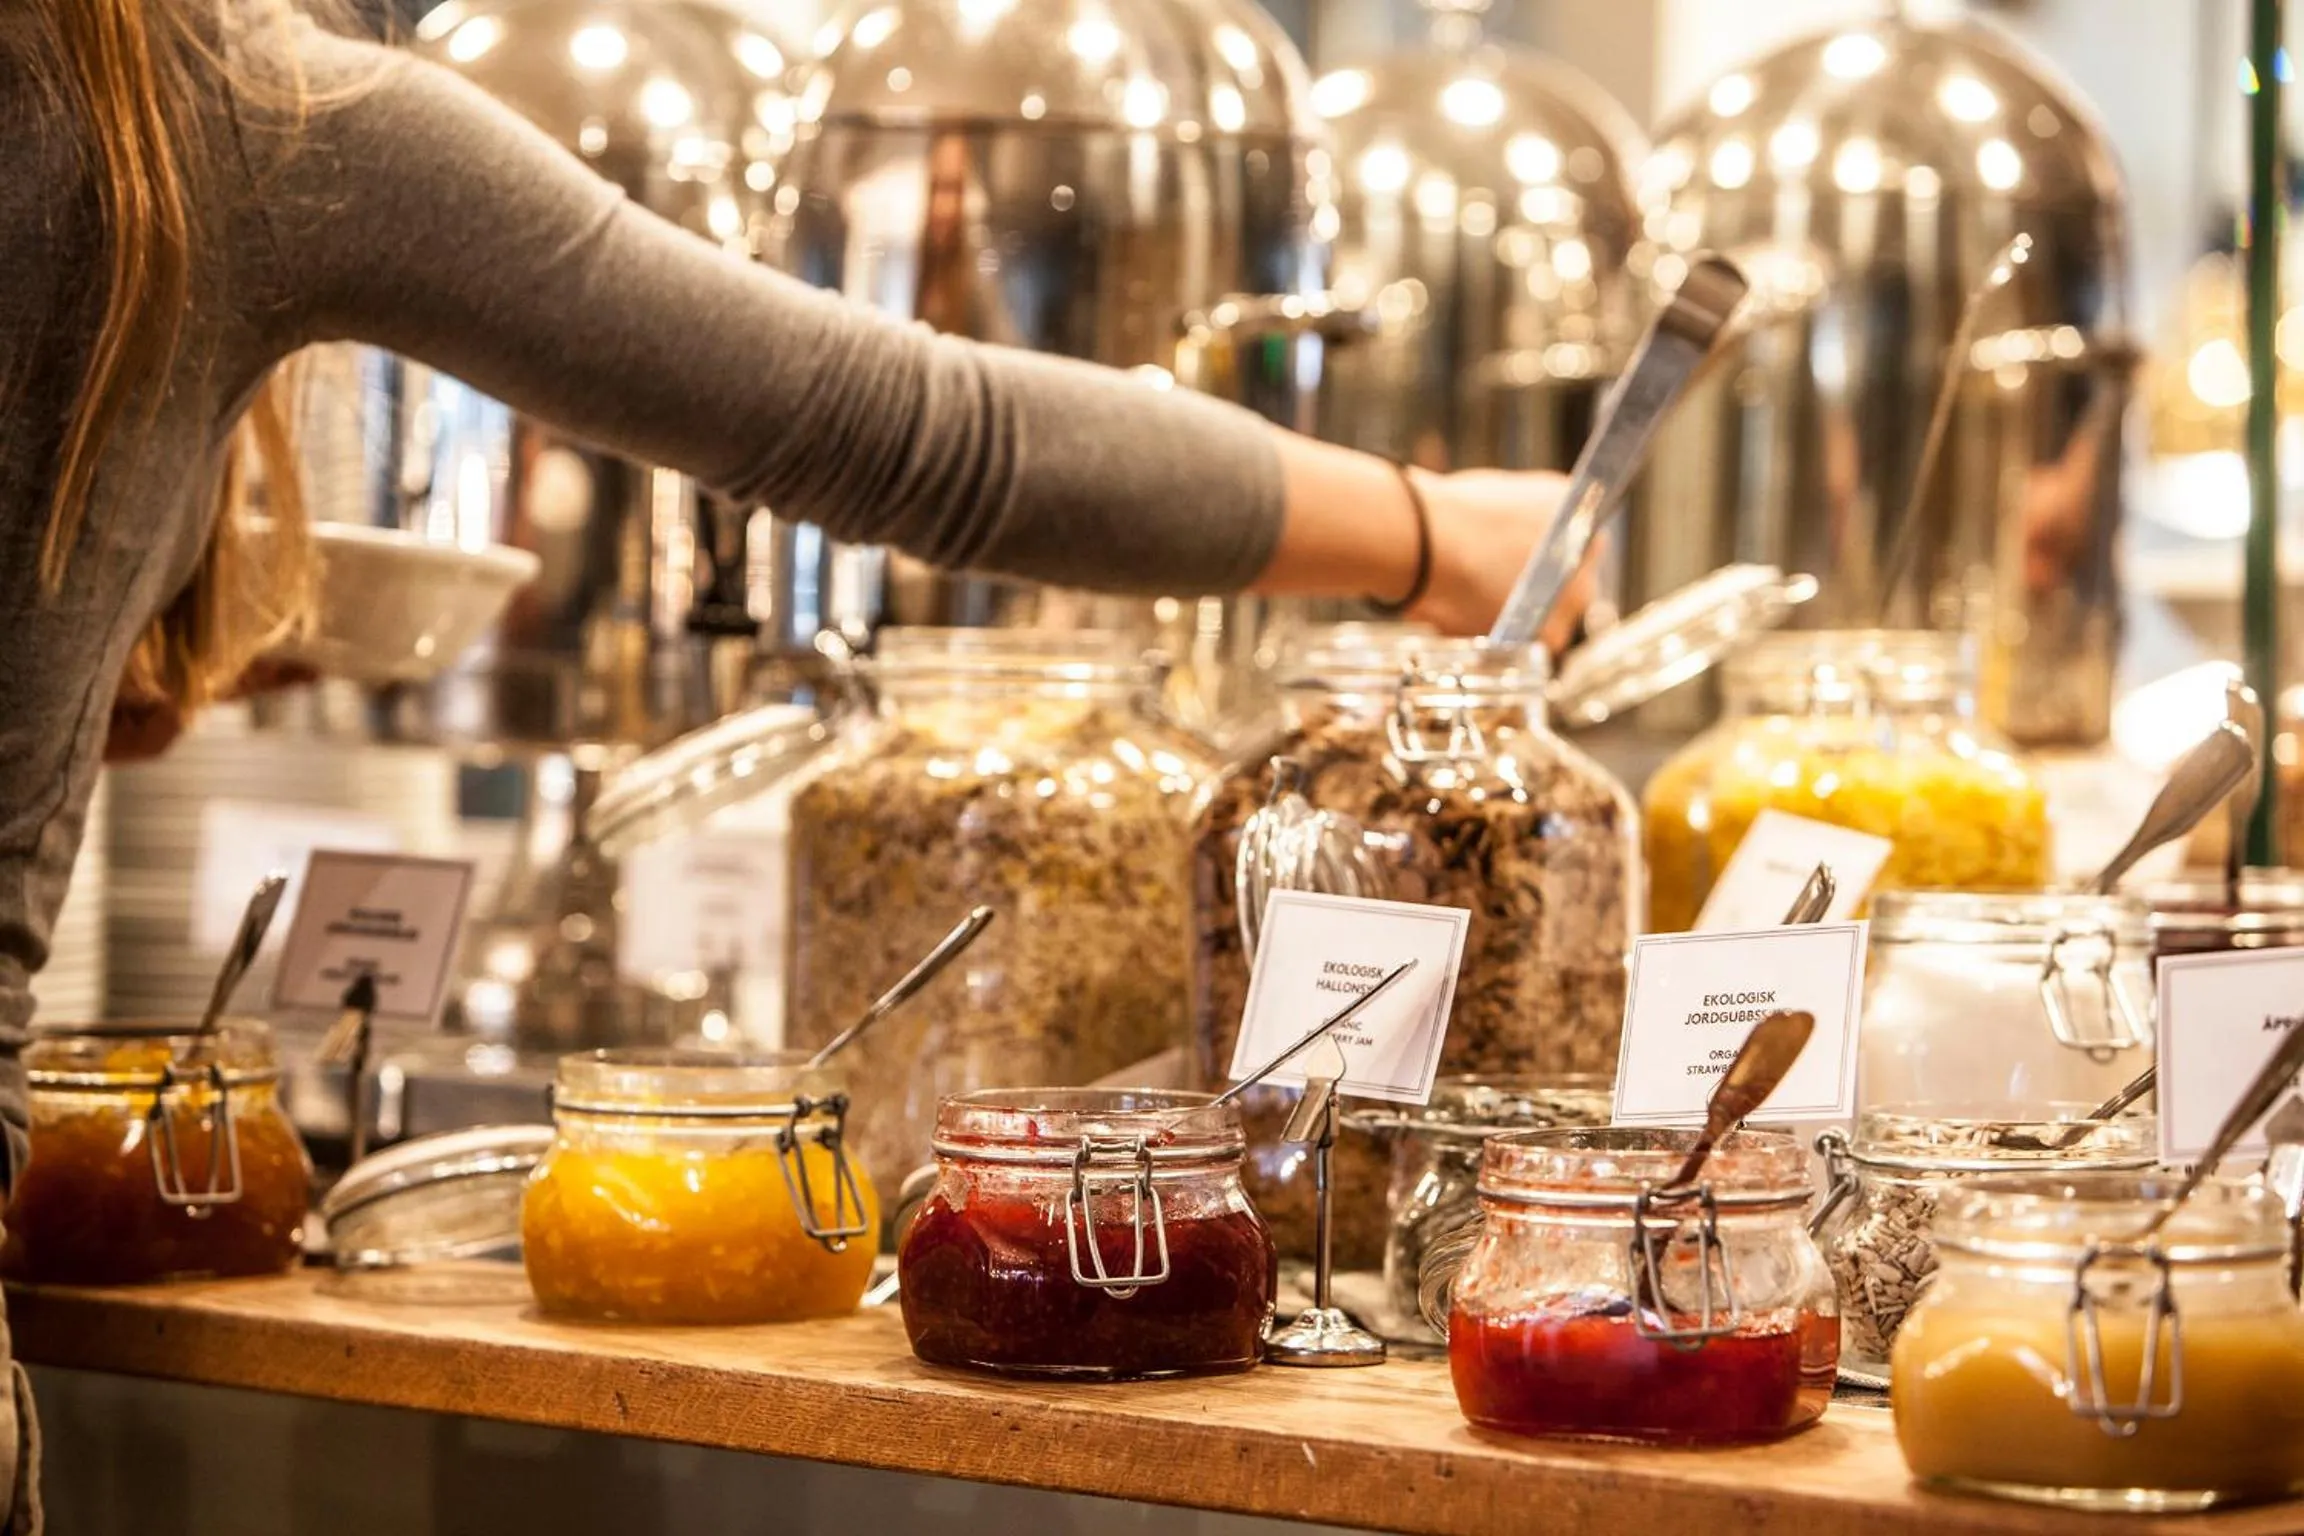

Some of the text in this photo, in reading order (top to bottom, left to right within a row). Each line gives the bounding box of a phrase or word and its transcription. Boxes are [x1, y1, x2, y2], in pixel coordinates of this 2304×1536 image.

[1323, 961, 1384, 979] EKOLOGISK
[1703, 990, 1776, 1007] EKOLOGISK
[1708, 1049, 1739, 1060] ORGA
